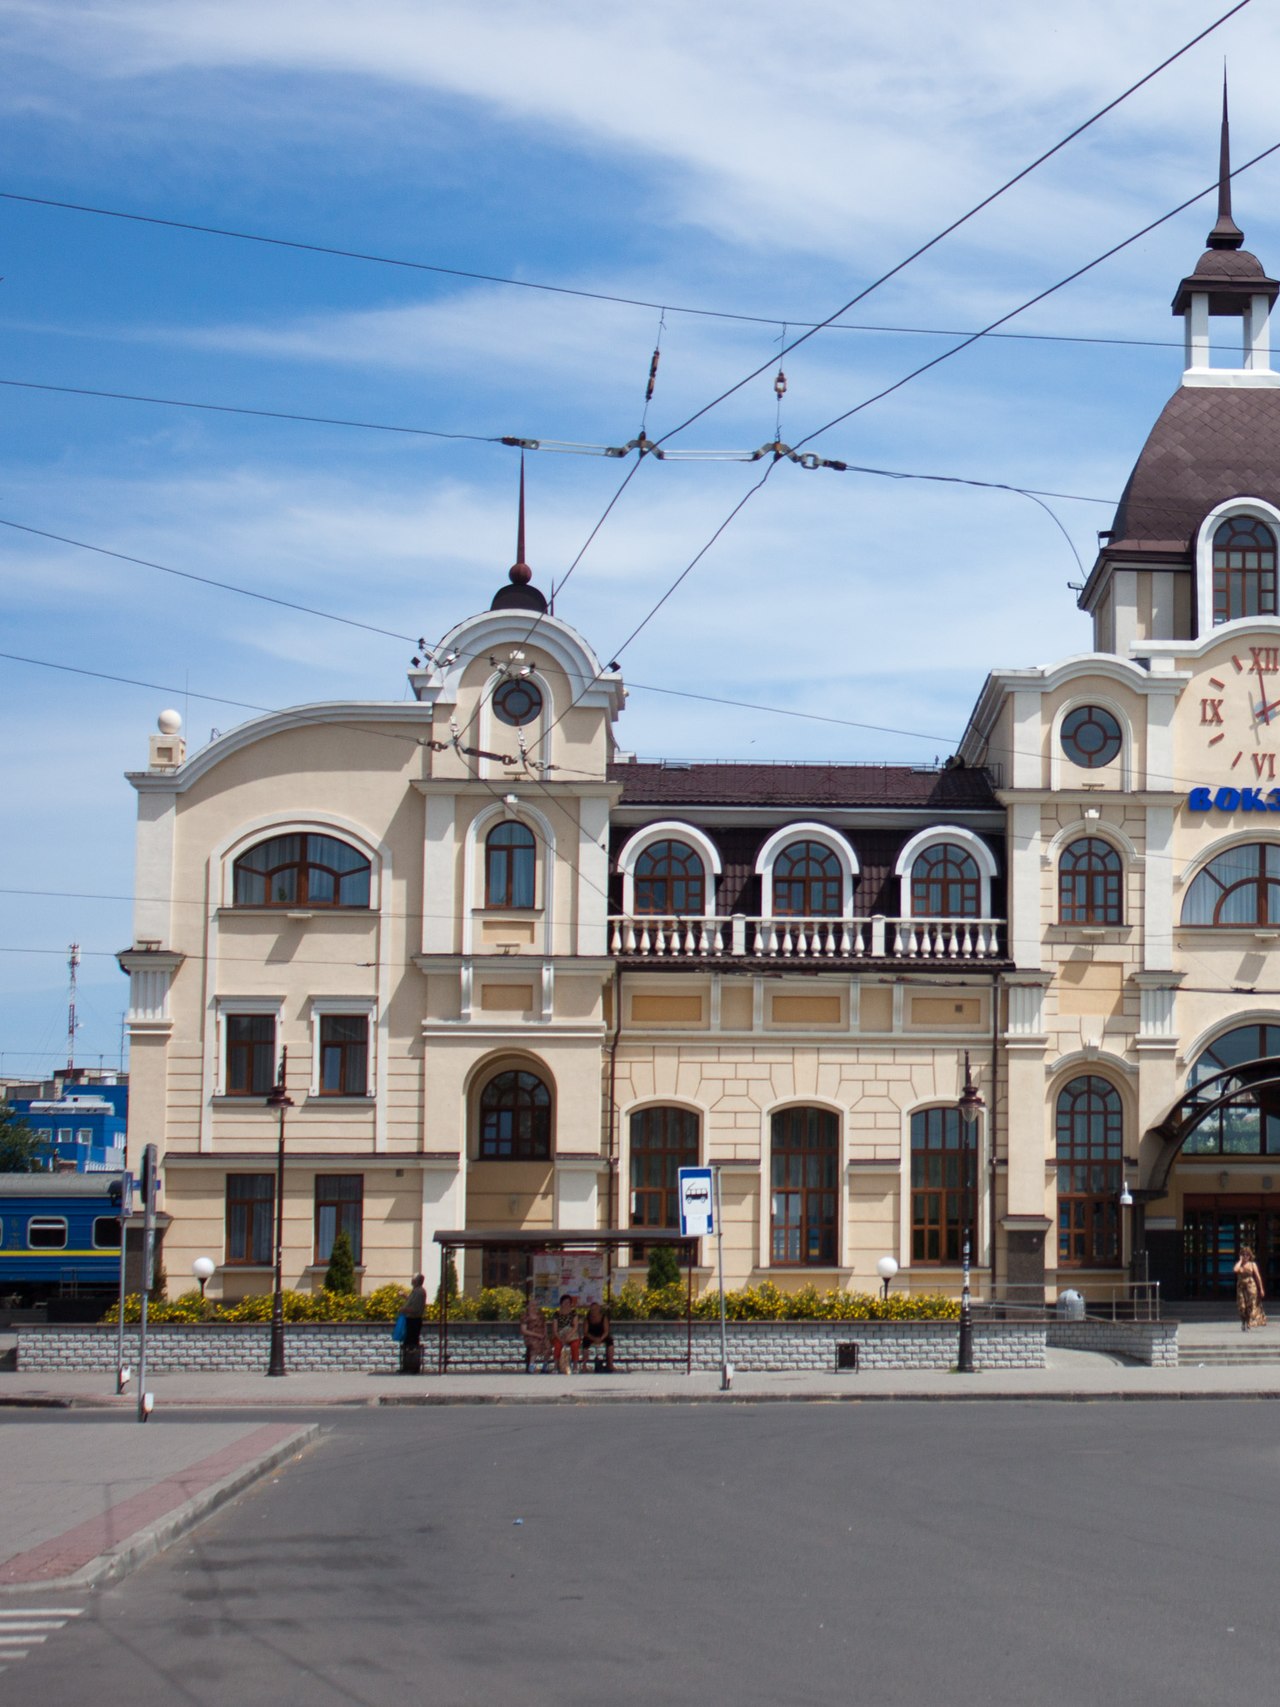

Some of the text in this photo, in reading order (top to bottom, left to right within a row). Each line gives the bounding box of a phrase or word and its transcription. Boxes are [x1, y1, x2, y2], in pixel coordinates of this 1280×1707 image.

[1249, 647, 1279, 671] XII
[1201, 699, 1224, 723] IX
[1252, 753, 1276, 778] VI
